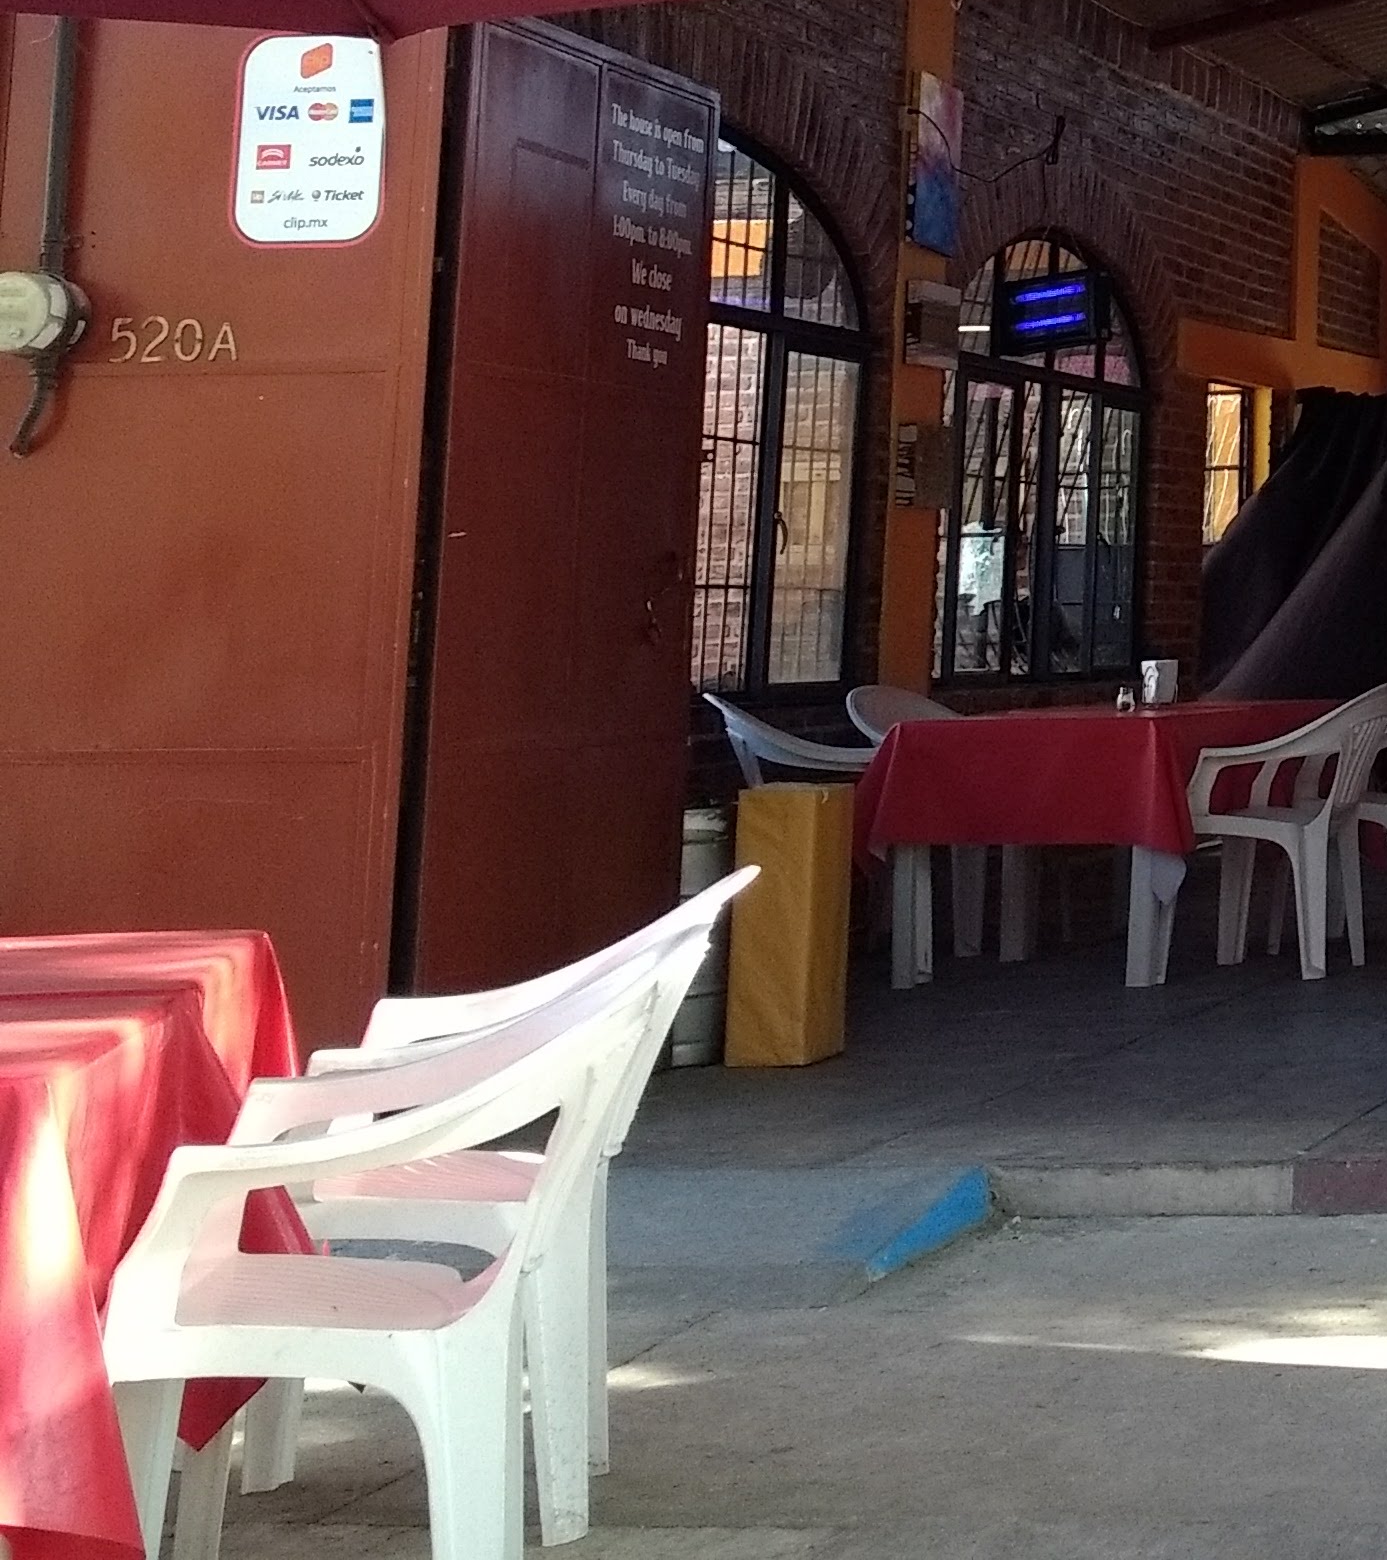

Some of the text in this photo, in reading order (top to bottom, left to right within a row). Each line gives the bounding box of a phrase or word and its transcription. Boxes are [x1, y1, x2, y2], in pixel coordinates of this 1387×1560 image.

[255, 105, 299, 121] VISA
[612, 103, 628, 128] The
[629, 109, 653, 136] house
[662, 127, 682, 149] open
[684, 128, 704, 153] from
[309, 149, 365, 167] sodexo
[613, 140, 700, 192] Thursday to Tuesday
[324, 190, 365, 201] Ticket
[622, 180, 687, 218] Every day from
[284, 217, 328, 230] clip.mx
[648, 226, 658, 246] to
[632, 258, 673, 291] We close
[614, 304, 682, 342] on wednesday
[108, 315, 238, 363] 520A
[626, 338, 668, 368] Thank you
